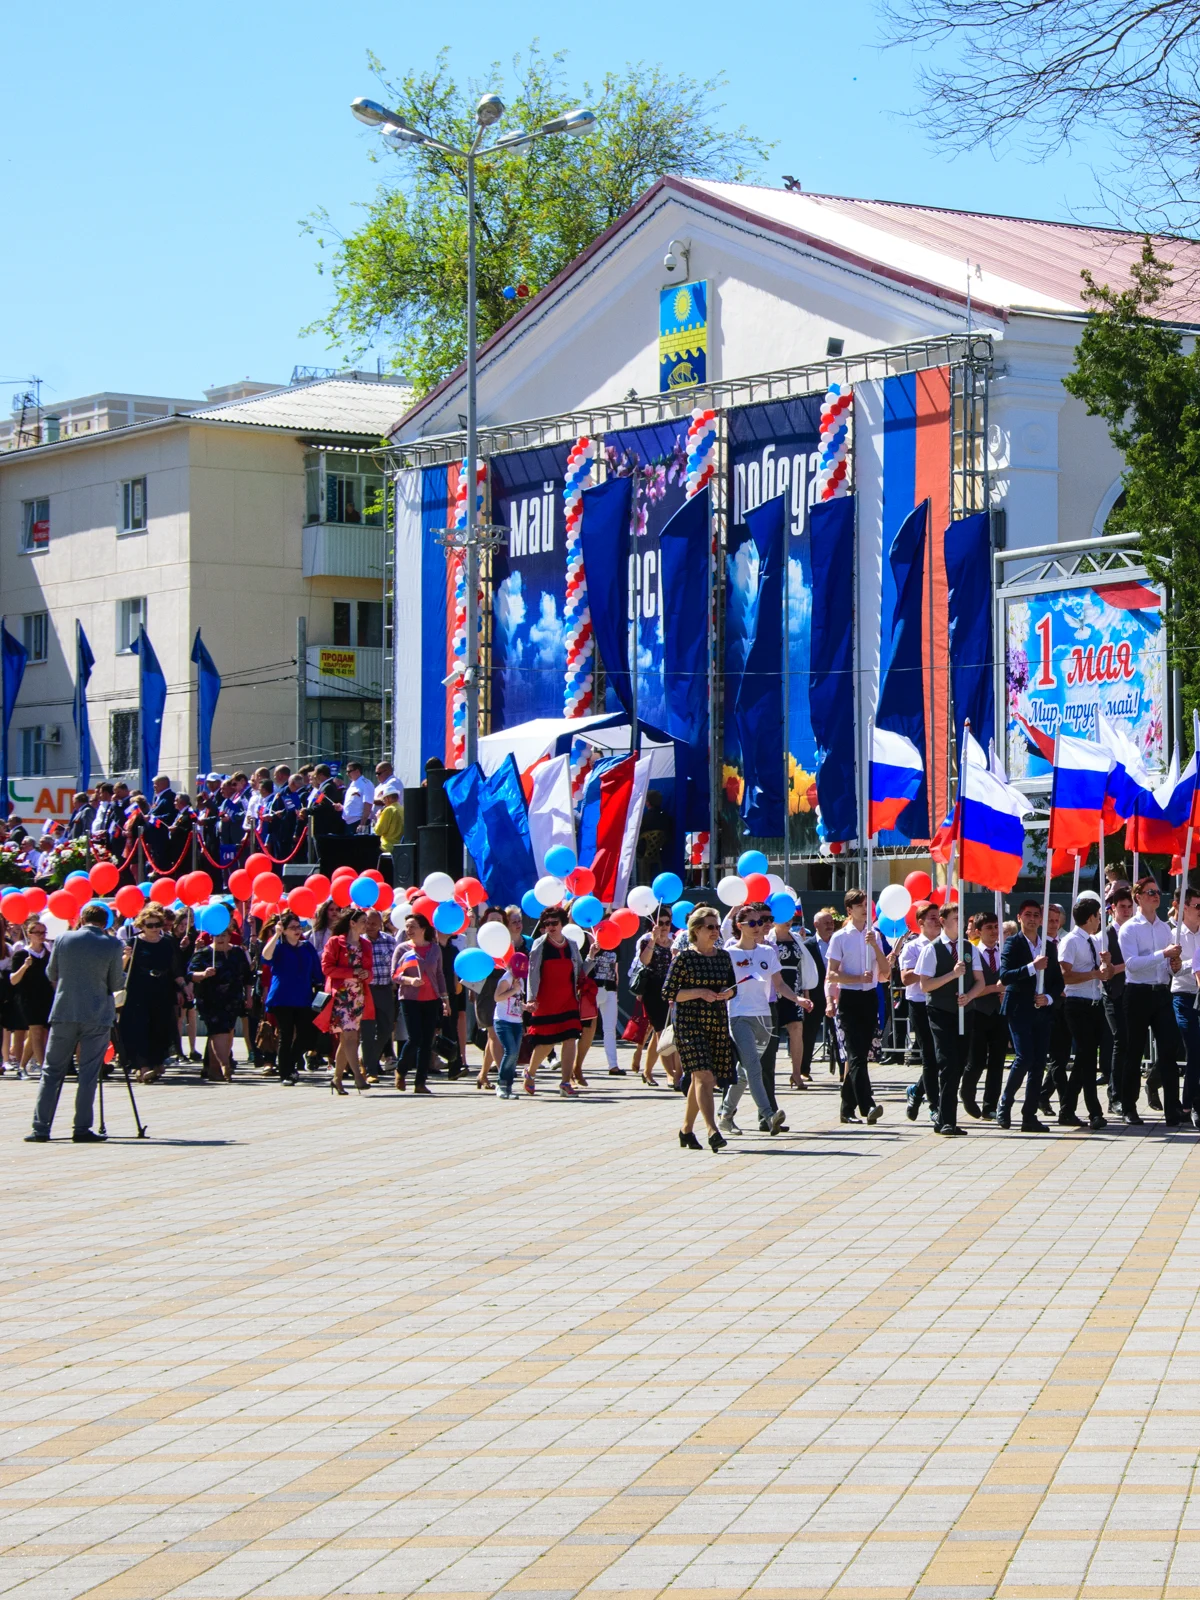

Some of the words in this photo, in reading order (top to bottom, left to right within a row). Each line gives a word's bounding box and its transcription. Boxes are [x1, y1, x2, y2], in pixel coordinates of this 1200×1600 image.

[321, 653, 355, 663] ПРОДАМ
[1037, 616, 1055, 686] 1
[1066, 642, 1135, 684] мая
